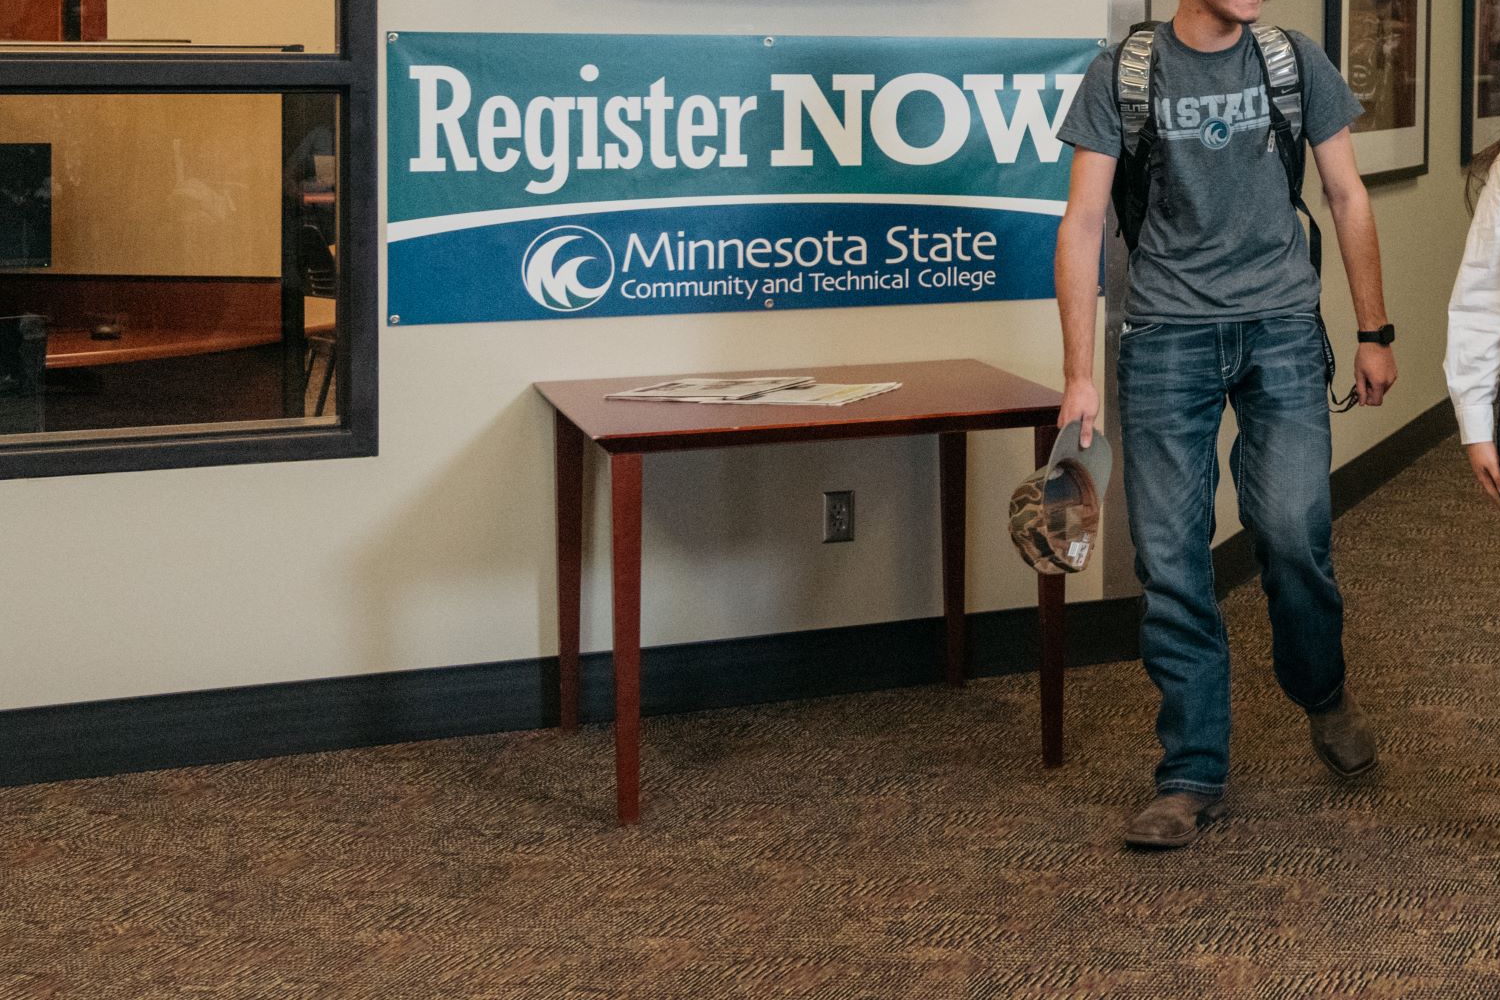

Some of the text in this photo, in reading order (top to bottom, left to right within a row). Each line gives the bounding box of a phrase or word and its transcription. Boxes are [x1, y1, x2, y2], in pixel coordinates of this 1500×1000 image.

[409, 63, 1086, 195] Register NOW
[621, 225, 997, 272] Minnesota State
[620, 266, 996, 300] Community and Technical College
